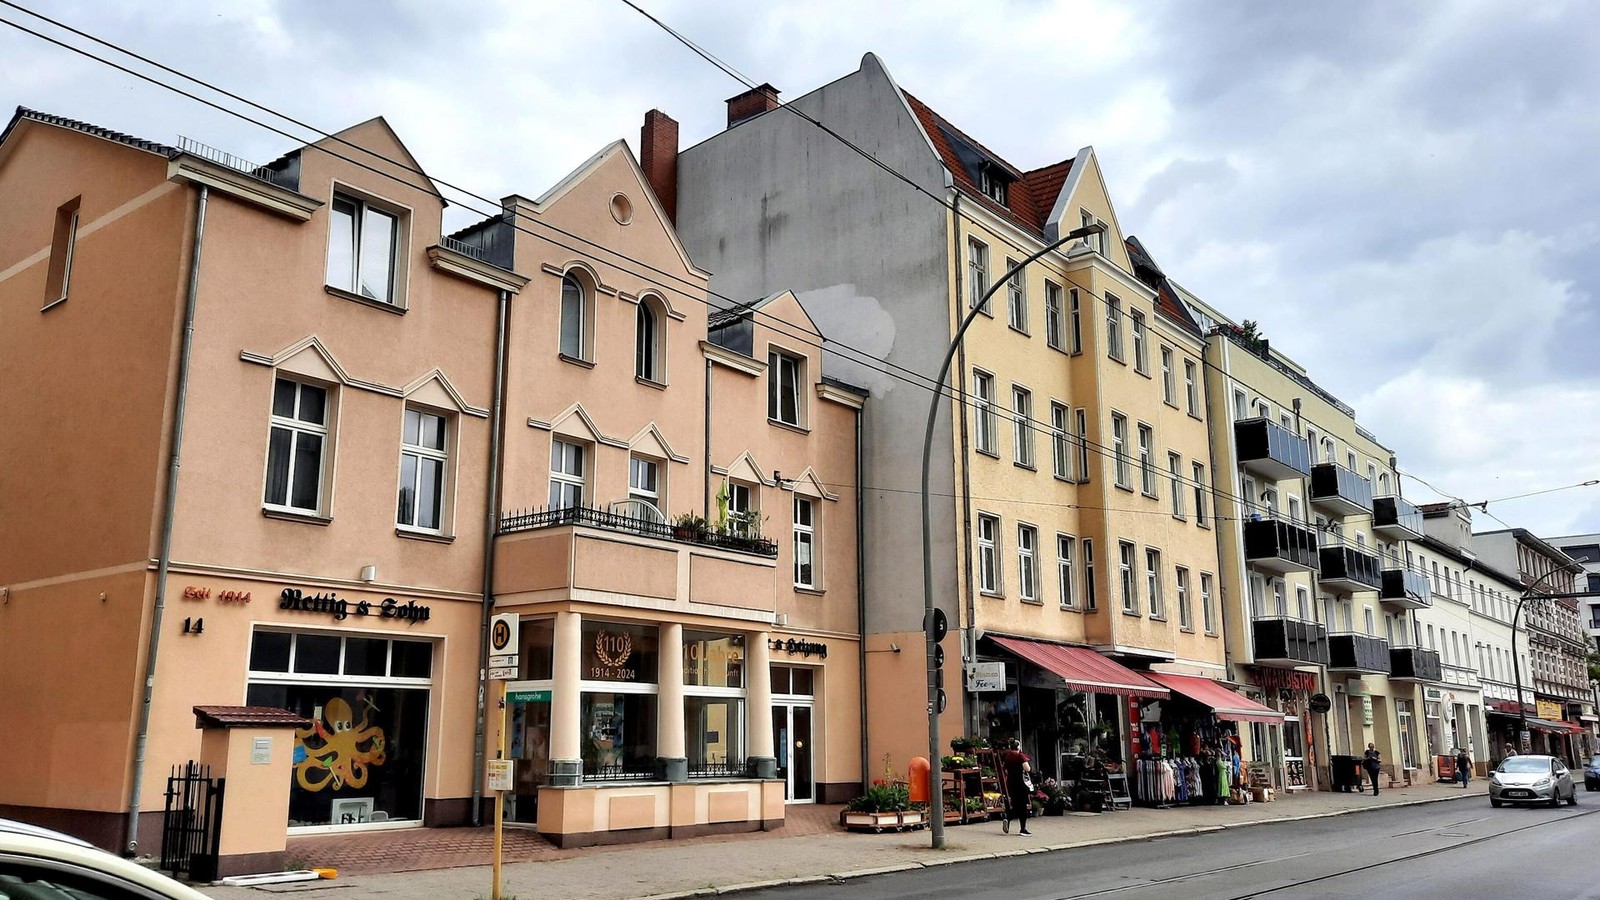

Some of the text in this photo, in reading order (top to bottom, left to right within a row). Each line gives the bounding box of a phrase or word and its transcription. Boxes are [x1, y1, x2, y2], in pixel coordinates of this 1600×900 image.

[184, 586, 252, 604] Seit 1914
[280, 588, 430, 629] Rettig & Sohn
[184, 617, 205, 634] 14
[495, 626, 505, 644] H
[603, 635, 624, 653] 110
[683, 643, 699, 661] 10
[591, 667, 610, 678] 1914
[616, 668, 636, 680] 2024
[515, 692, 542, 701] hansgrohe
